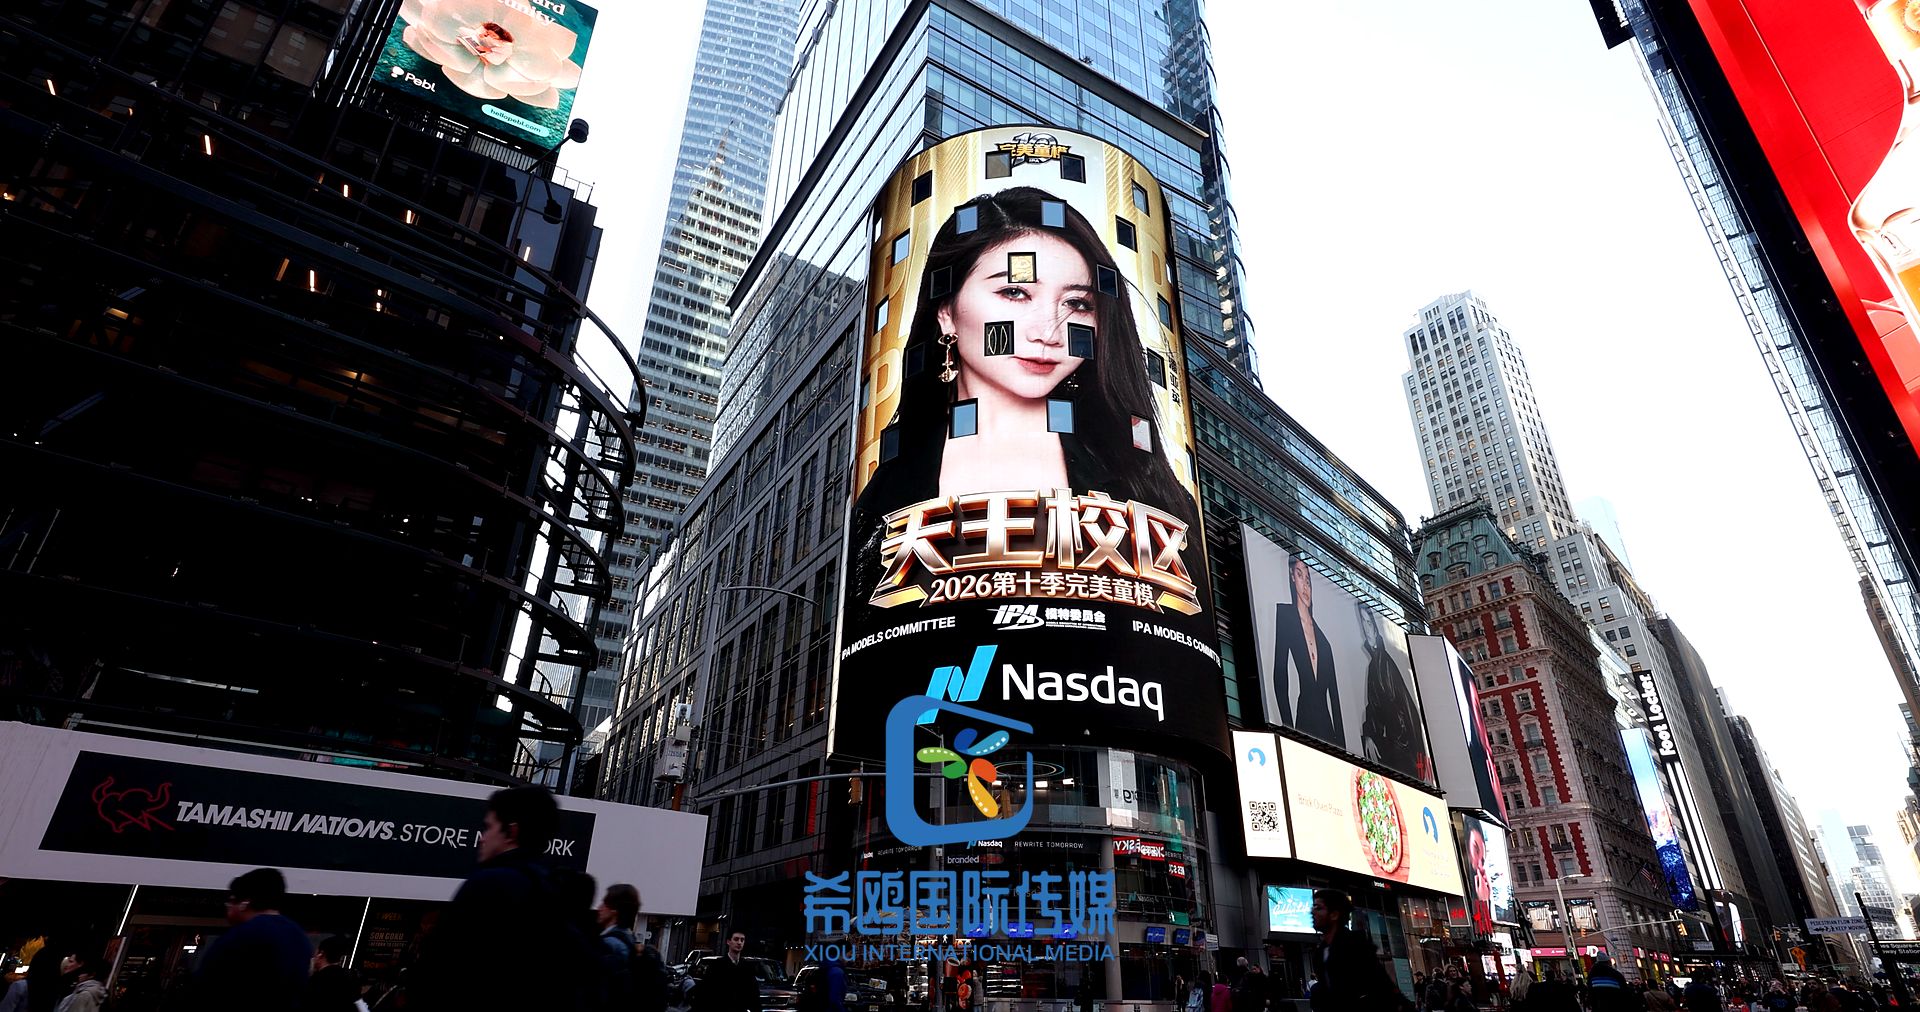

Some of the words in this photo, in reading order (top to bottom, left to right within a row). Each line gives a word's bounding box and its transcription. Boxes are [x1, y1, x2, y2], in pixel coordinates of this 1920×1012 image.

[405, 72, 436, 93] Pebl
[490, 108, 542, 133] hellopebl.com
[874, 487, 1198, 590] 天王校区
[930, 571, 1157, 608] 2026第十季完美童模
[993, 604, 1040, 625] IPA
[1045, 607, 1106, 623] 模特委员会
[851, 631, 884, 655] MODELS
[884, 616, 956, 640] COMMITTEE
[1132, 620, 1152, 635] IPA
[1153, 624, 1193, 647] MODELS
[1002, 663, 1165, 722] Nasdaq
[1639, 673, 1665, 722] Locker
[1652, 723, 1677, 756] Foot
[176, 801, 293, 831] TAMASHII
[292, 813, 395, 840] NATIONS
[400, 823, 469, 849] STORE
[977, 839, 1003, 848] Nasdaq
[1047, 841, 1084, 849] TOMORROW
[947, 855, 980, 864] branded
